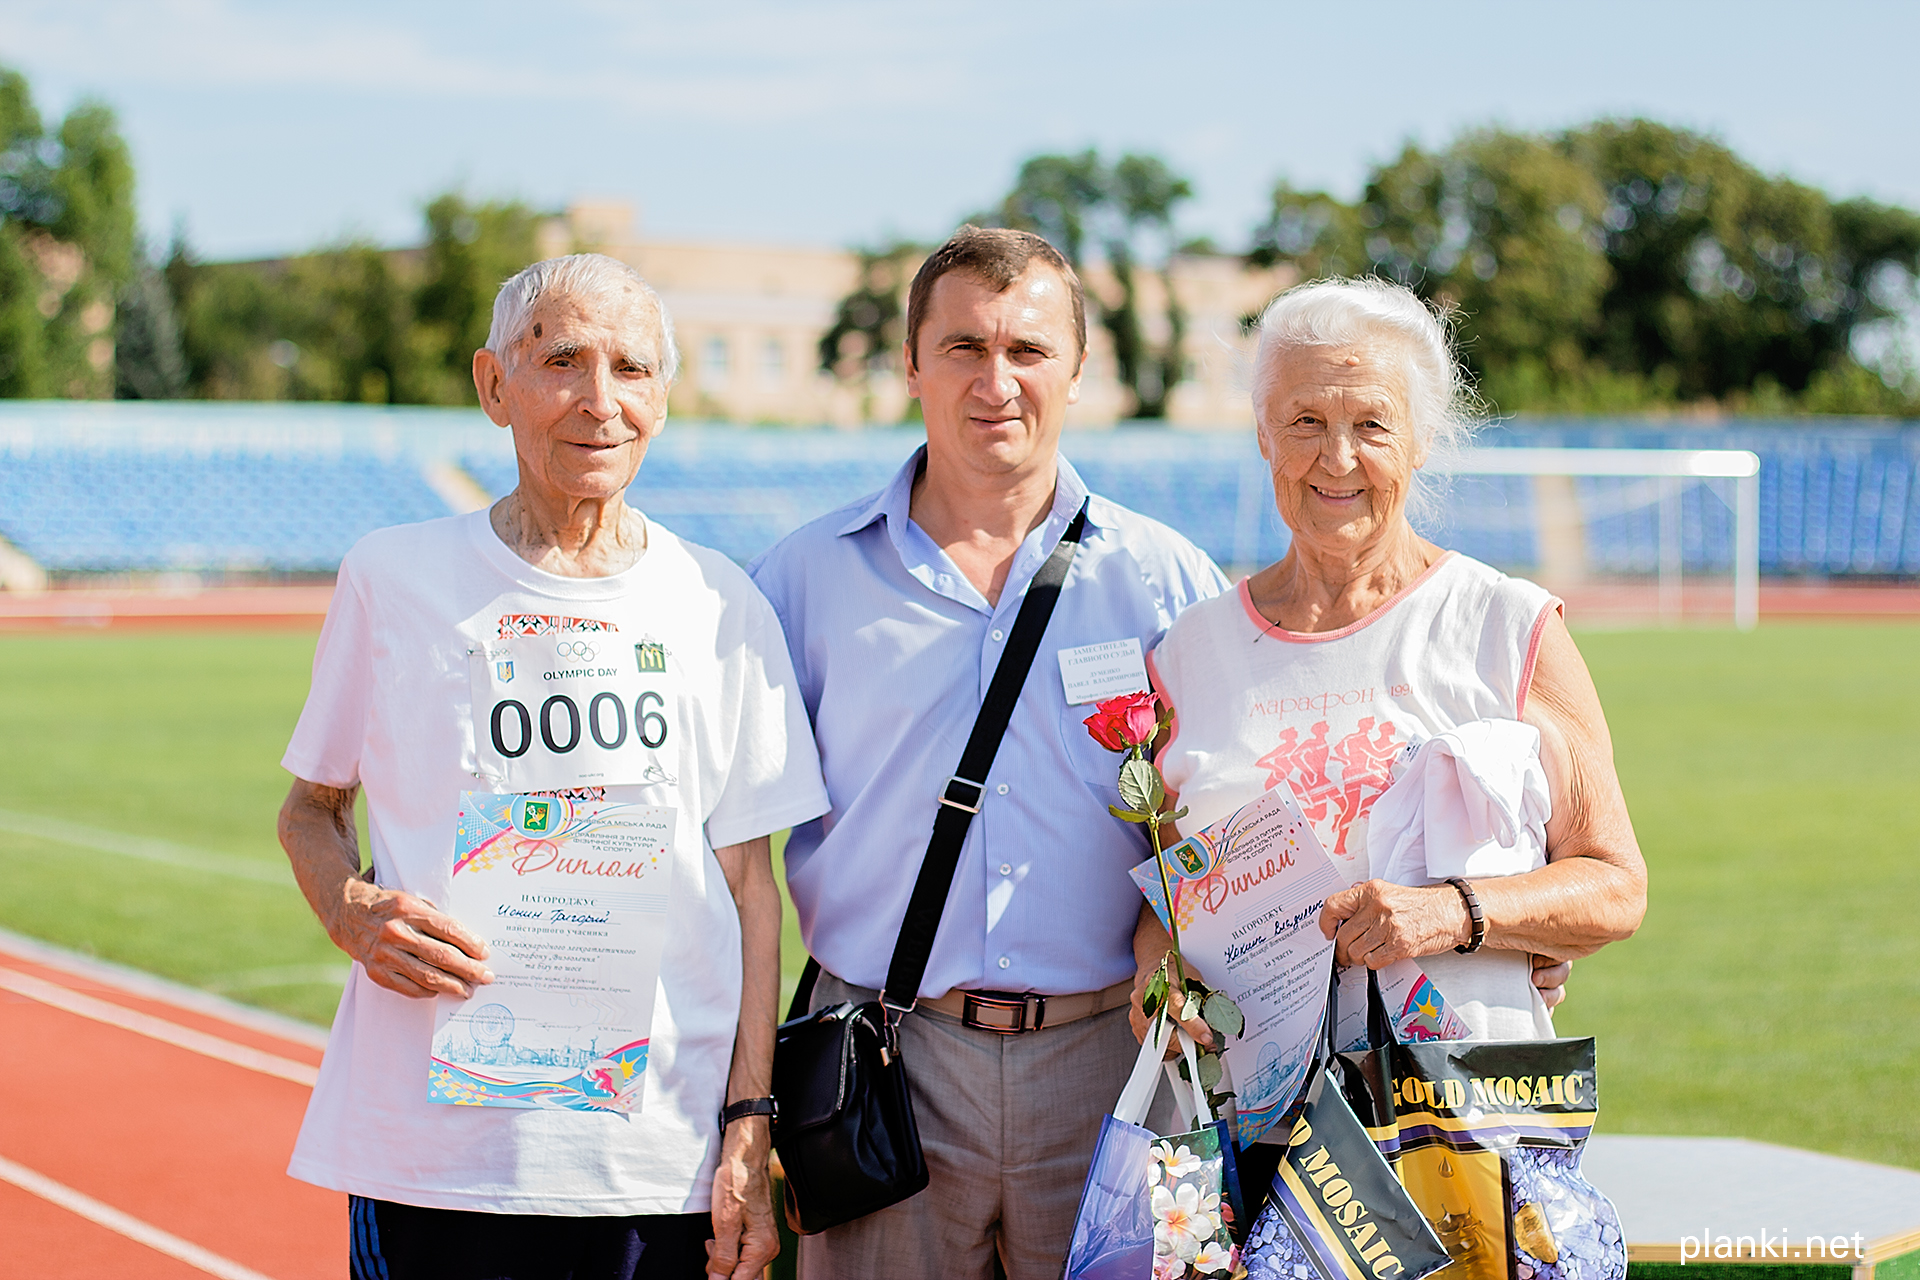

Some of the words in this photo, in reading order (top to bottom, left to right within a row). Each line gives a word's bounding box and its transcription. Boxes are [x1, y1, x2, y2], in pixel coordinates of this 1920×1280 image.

[1068, 653, 1109, 666] ГЛАВНОГО
[1110, 649, 1136, 660] СУДЬИ
[1073, 642, 1127, 655] ЗАМЕСТИТЕЛЬ
[543, 668, 595, 681] OLYMPIC
[598, 668, 618, 678] DAY
[1068, 680, 1090, 689] ПАВЕЛ
[1093, 671, 1144, 685] ВЛАДИМИРОВИЧ
[1249, 687, 1375, 720] марафон
[490, 691, 667, 759] 0006
[614, 820, 644, 828] МІСЬКА
[646, 822, 667, 830] РАДА
[1242, 817, 1265, 832] МІСЬКА
[1264, 807, 1281, 819] РАДА
[570, 832, 618, 840] УПРАВЛІННЯ
[1254, 830, 1284, 849] КУЛЬТУРИ
[1260, 824, 1283, 837] ПИТАНЬ
[1251, 842, 1273, 857] СПОРТУ
[511, 839, 645, 879] Диплом
[1193, 849, 1295, 915] Диплом
[566, 928, 608, 937] учасника
[1271, 948, 1294, 966] участь
[1391, 1076, 1466, 1109] GOLD
[1469, 1074, 1584, 1107] MOSAIC
[1299, 1145, 1405, 1280] MOSAIC
